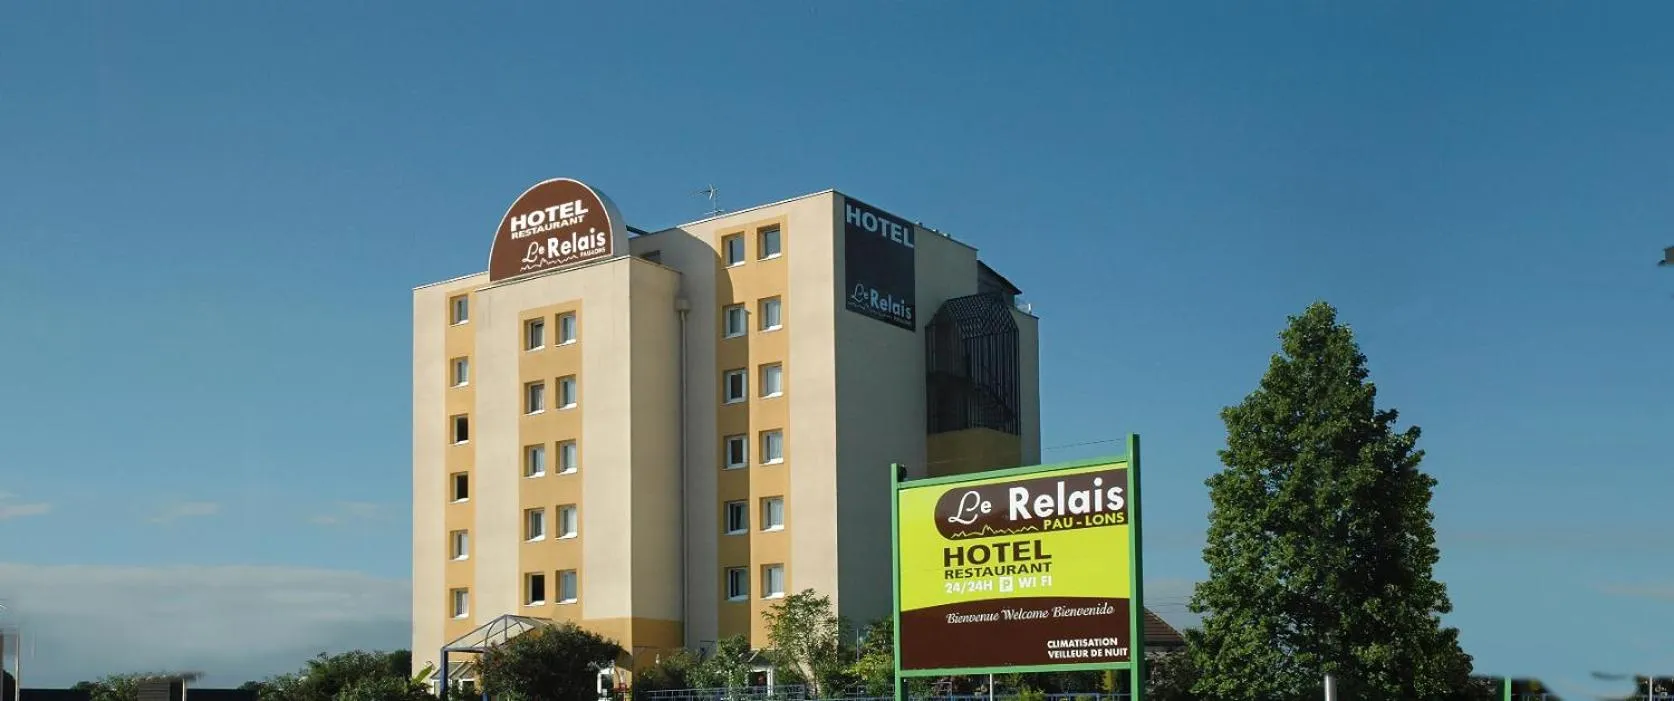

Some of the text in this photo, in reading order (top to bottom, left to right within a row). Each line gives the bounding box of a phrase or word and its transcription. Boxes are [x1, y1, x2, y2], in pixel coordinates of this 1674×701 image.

[510, 200, 588, 232] HOTEL
[511, 215, 585, 240] RESTAURANT
[846, 204, 914, 248] HOTEL
[522, 227, 606, 263] Le Relais
[870, 287, 912, 320] Relais
[948, 477, 1125, 525] Le Relais
[1044, 517, 1074, 531] PAU
[1085, 512, 1125, 527] LONS
[943, 539, 1052, 568] HOTEL
[944, 562, 1053, 580] RESTAURANT
[944, 579, 993, 595] 24/24H
[946, 602, 1115, 625] Bienvenue Welcome Bienvenido
[1047, 637, 1118, 649] CLIMATISATION
[1048, 648, 1128, 660] VEILLEUR DE NUIT
